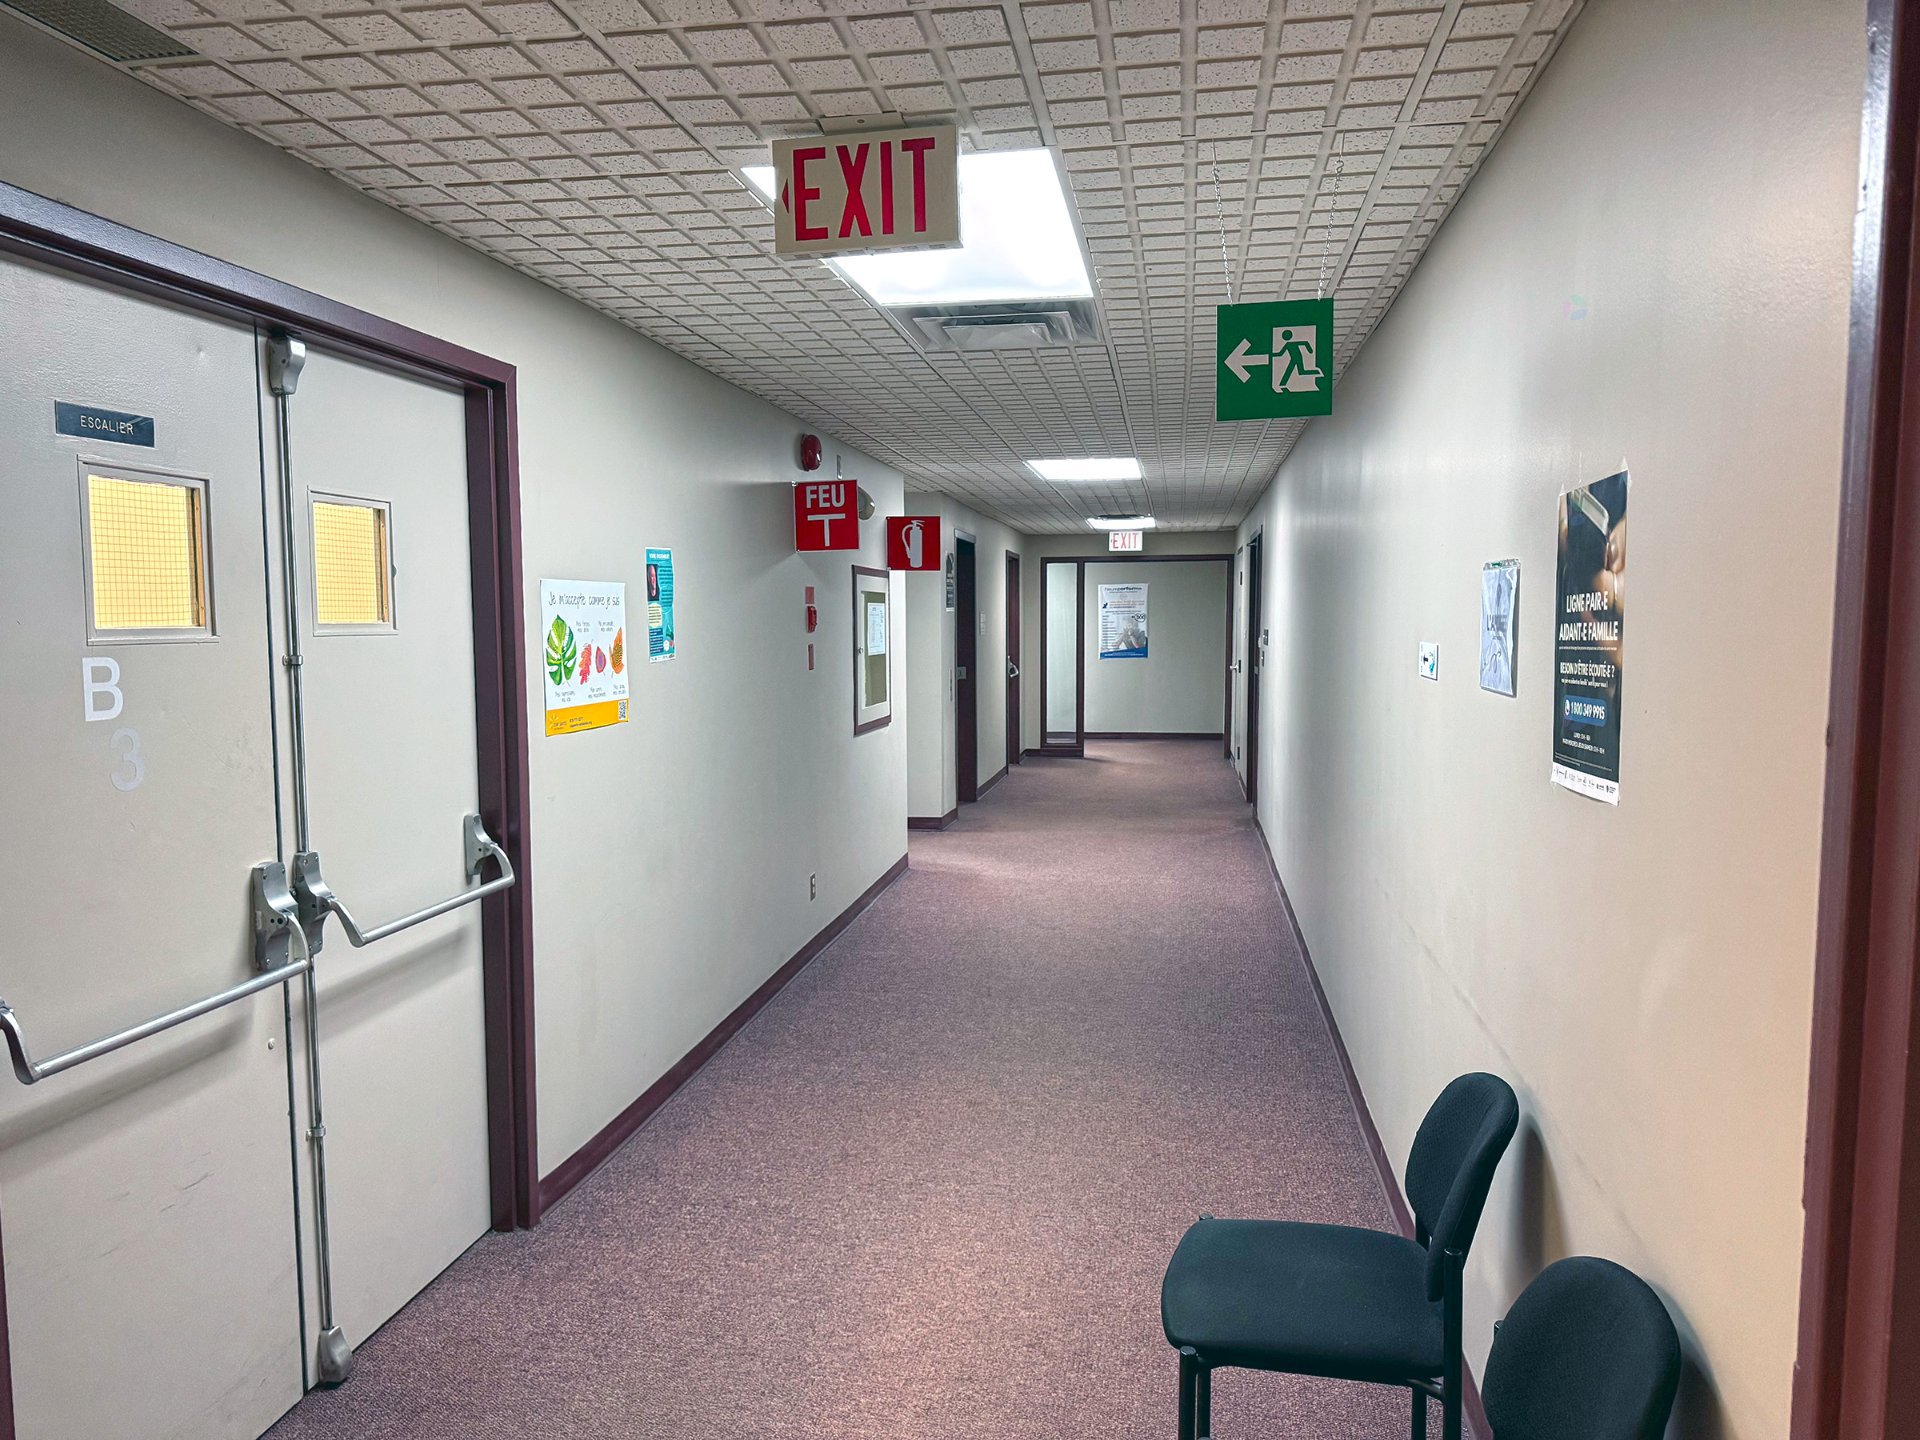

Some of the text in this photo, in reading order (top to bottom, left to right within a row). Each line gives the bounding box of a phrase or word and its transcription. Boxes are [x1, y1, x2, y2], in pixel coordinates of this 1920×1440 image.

[793, 137, 935, 241] EXIT
[80, 415, 134, 436] ESCALIER
[806, 484, 845, 509] FEU
[1112, 532, 1139, 549] EXIT
[1566, 593, 1585, 613] LIGNE
[1588, 621, 1619, 641] FAMILLE
[1560, 662, 1574, 674] BESOIN
[82, 657, 124, 721] B
[110, 727, 145, 792] 3
